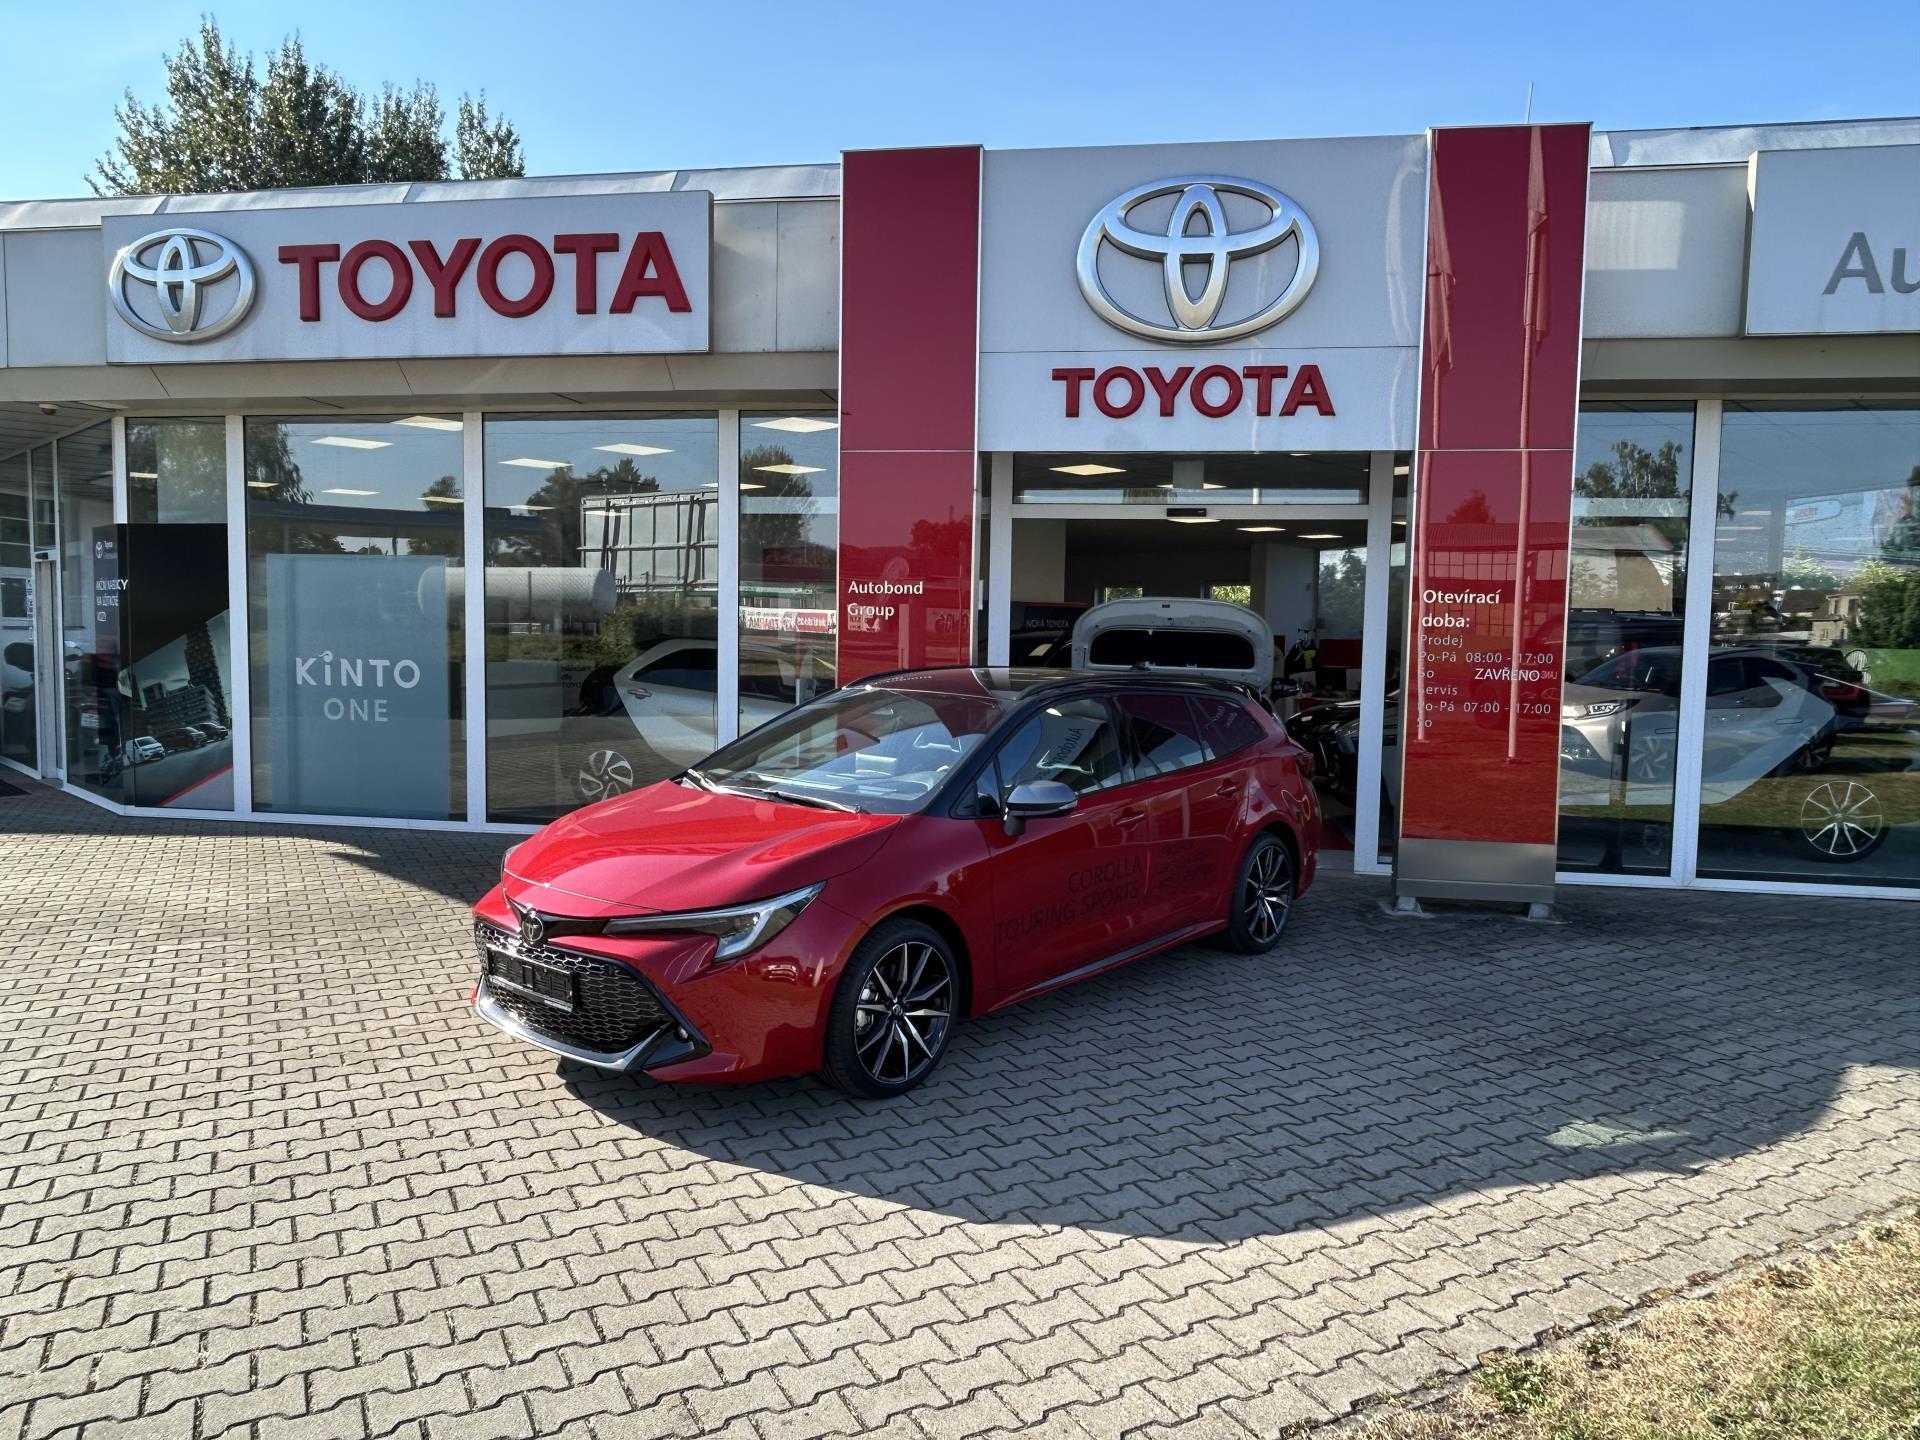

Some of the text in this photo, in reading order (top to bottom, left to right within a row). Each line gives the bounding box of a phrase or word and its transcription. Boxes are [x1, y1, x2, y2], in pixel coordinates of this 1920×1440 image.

[1822, 232, 1920, 295] Au
[278, 231, 692, 323] TOYOTA
[1052, 364, 1336, 418] TOYOTA
[847, 580, 923, 595] Autobond
[1422, 588, 1502, 604] Otevírací
[847, 602, 895, 620] Group
[1421, 612, 1470, 628] doba:
[1420, 635, 1463, 648] Prodej
[1465, 652, 1502, 663] 08:00
[1518, 653, 1554, 664] 17:00
[1474, 666, 1540, 682] ZAVŘENO
[323, 697, 389, 722] ONE
[1463, 702, 1500, 713] 07:00
[1517, 703, 1551, 714] 17:00
[1068, 855, 1142, 893] COROLLA
[994, 879, 1140, 945] TOURING SPORTS
